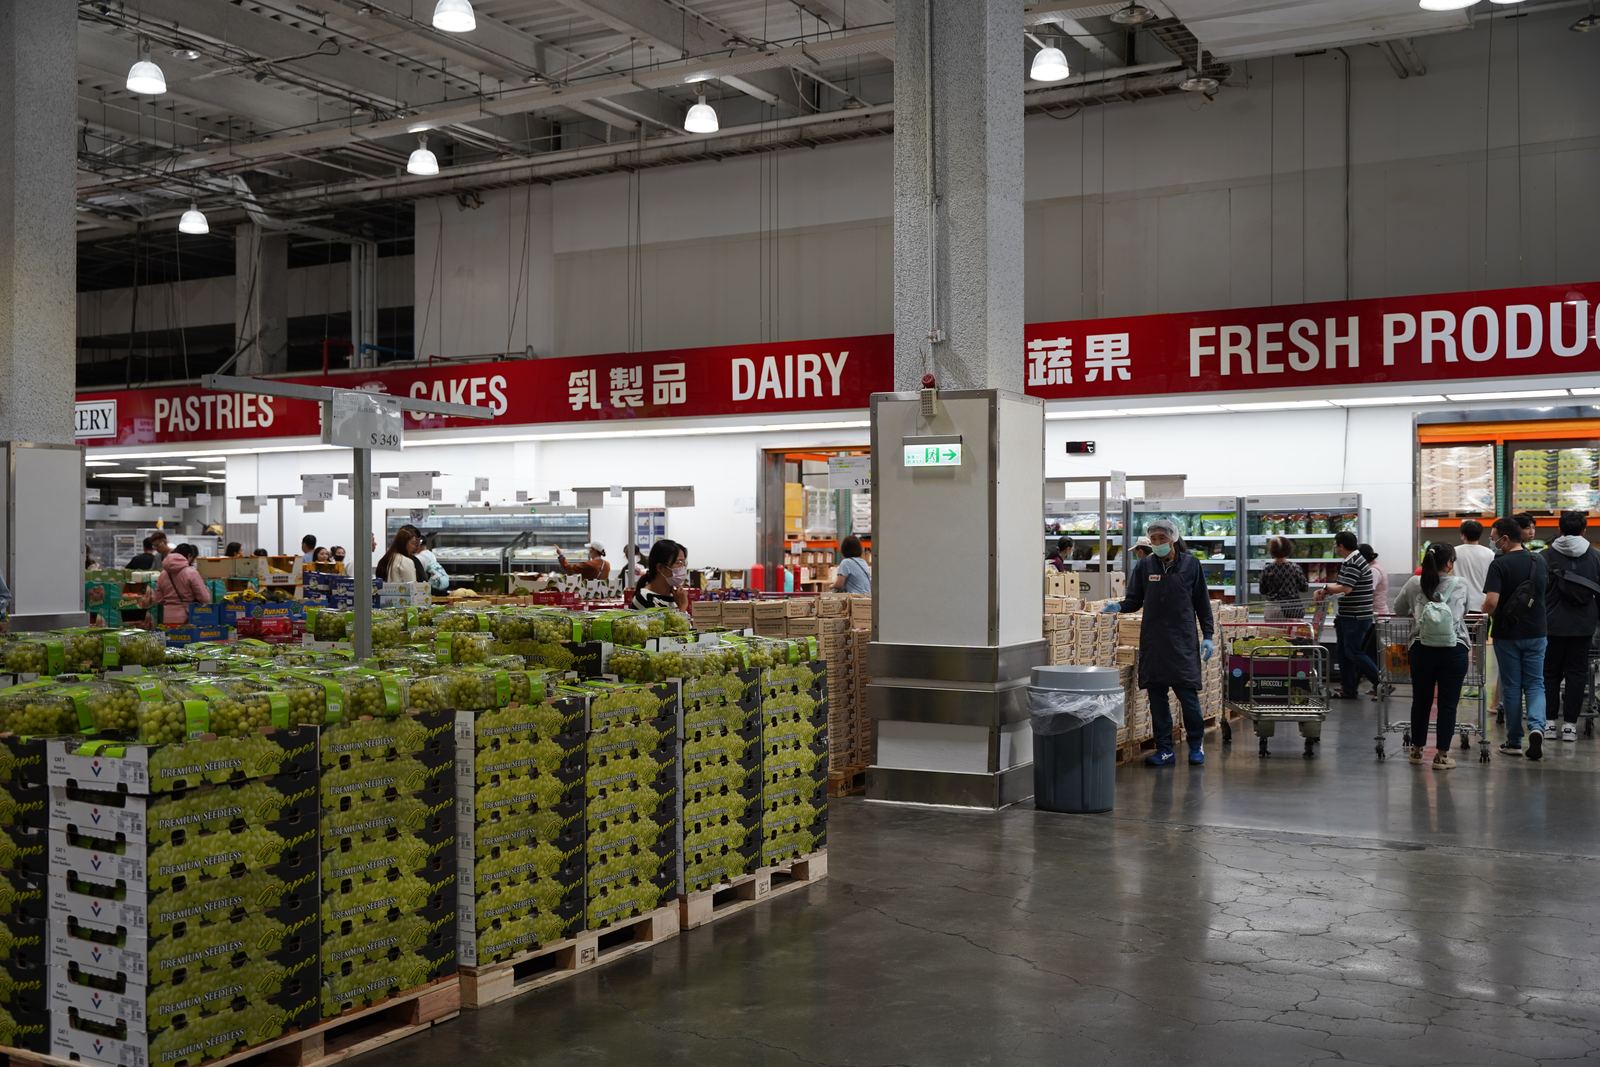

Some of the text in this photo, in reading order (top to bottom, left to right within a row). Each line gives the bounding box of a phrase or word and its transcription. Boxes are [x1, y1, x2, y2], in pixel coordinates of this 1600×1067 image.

[1027, 332, 1132, 387] 蔬果
[1189, 316, 1360, 378] FRESH
[409, 374, 508, 421] CAKES
[568, 362, 686, 411] 乳製品
[731, 351, 849, 401] DAIRY
[154, 393, 274, 433] PASTRIES
[379, 433, 399, 447] 349
[1260, 679, 1283, 688] BROCCOLI
[160, 764, 202, 779] PREMIUM
[204, 758, 242, 773] SEEDLESS
[255, 741, 316, 772] Grapes
[330, 741, 363, 753] PREMIUM
[365, 736, 394, 747] SEEDLESS
[405, 721, 454, 750] Grapes
[330, 760, 455, 795] PREMIUM SEEDLESS Grapes
[159, 814, 202, 830] PREMIUM
[204, 806, 242, 822] SEEDLESS
[255, 786, 316, 818] Grapes
[365, 816, 395, 829] SEEDLESS
[406, 797, 455, 827] Grapes
[159, 860, 202, 877] PREMIUM
[204, 851, 243, 868] SEEDLESS
[255, 828, 316, 862] Grapes
[331, 835, 455, 878] PREMIUM SEEDLESS Grapes
[160, 870, 317, 924] PREMIUM SEEDLESS Grapes
[331, 873, 455, 920] PREMIUM SEEDLESS Grapes
[160, 912, 318, 970] PREMIUM SEEDLESS Grapes
[331, 911, 455, 962] PREMIUM SEEDLESS Grapes
[159, 952, 318, 1015] PREMIUM SEEDLESS Grapes
[331, 950, 455, 1002] PREMIUM SEEDLESS Grapes
[161, 996, 318, 1062] PREMIUM SEEDLESS Grapes
